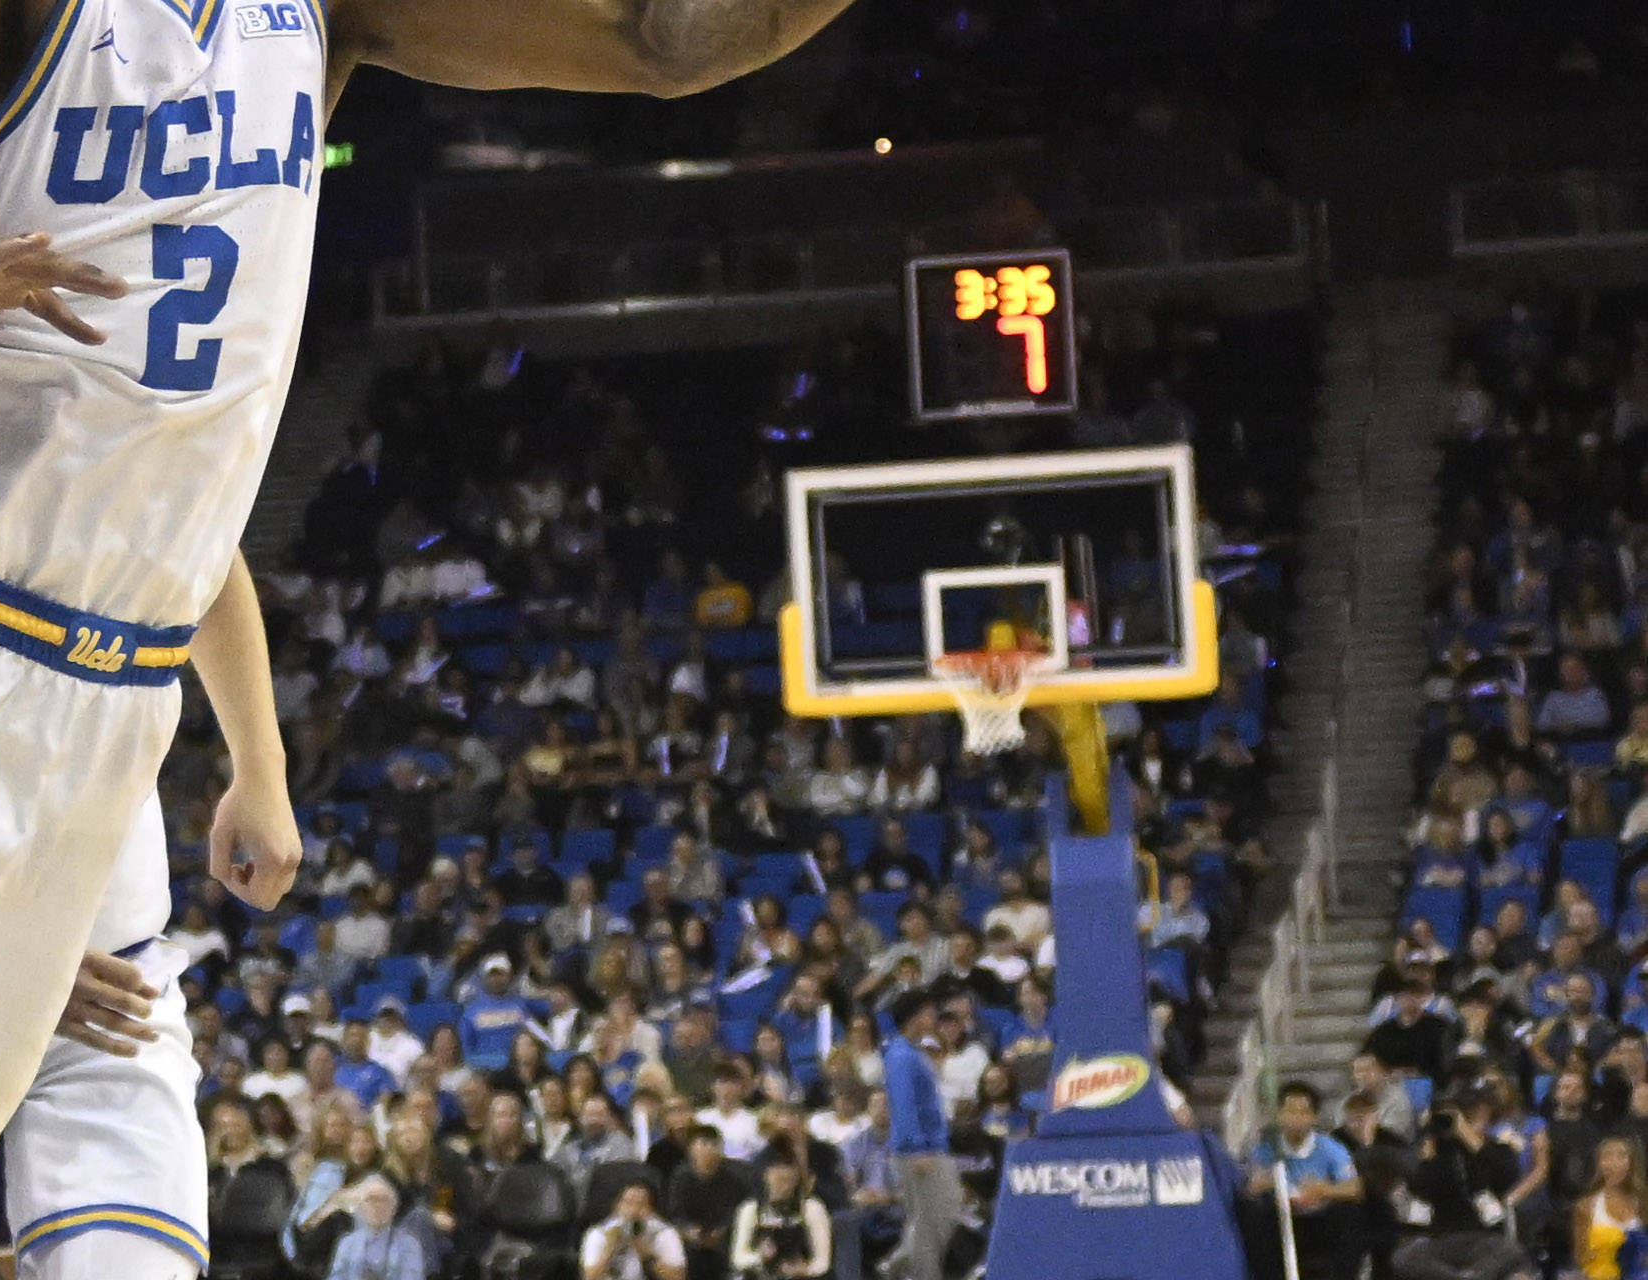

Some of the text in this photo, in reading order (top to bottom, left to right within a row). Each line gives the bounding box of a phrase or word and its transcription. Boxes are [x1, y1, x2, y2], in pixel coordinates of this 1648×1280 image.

[46, 90, 315, 205] UCLA
[139, 223, 240, 391] 2
[955, 264, 1056, 320] 3:35
[996, 314, 1048, 394] 7
[1010, 1160, 1149, 1195] WESCOM
